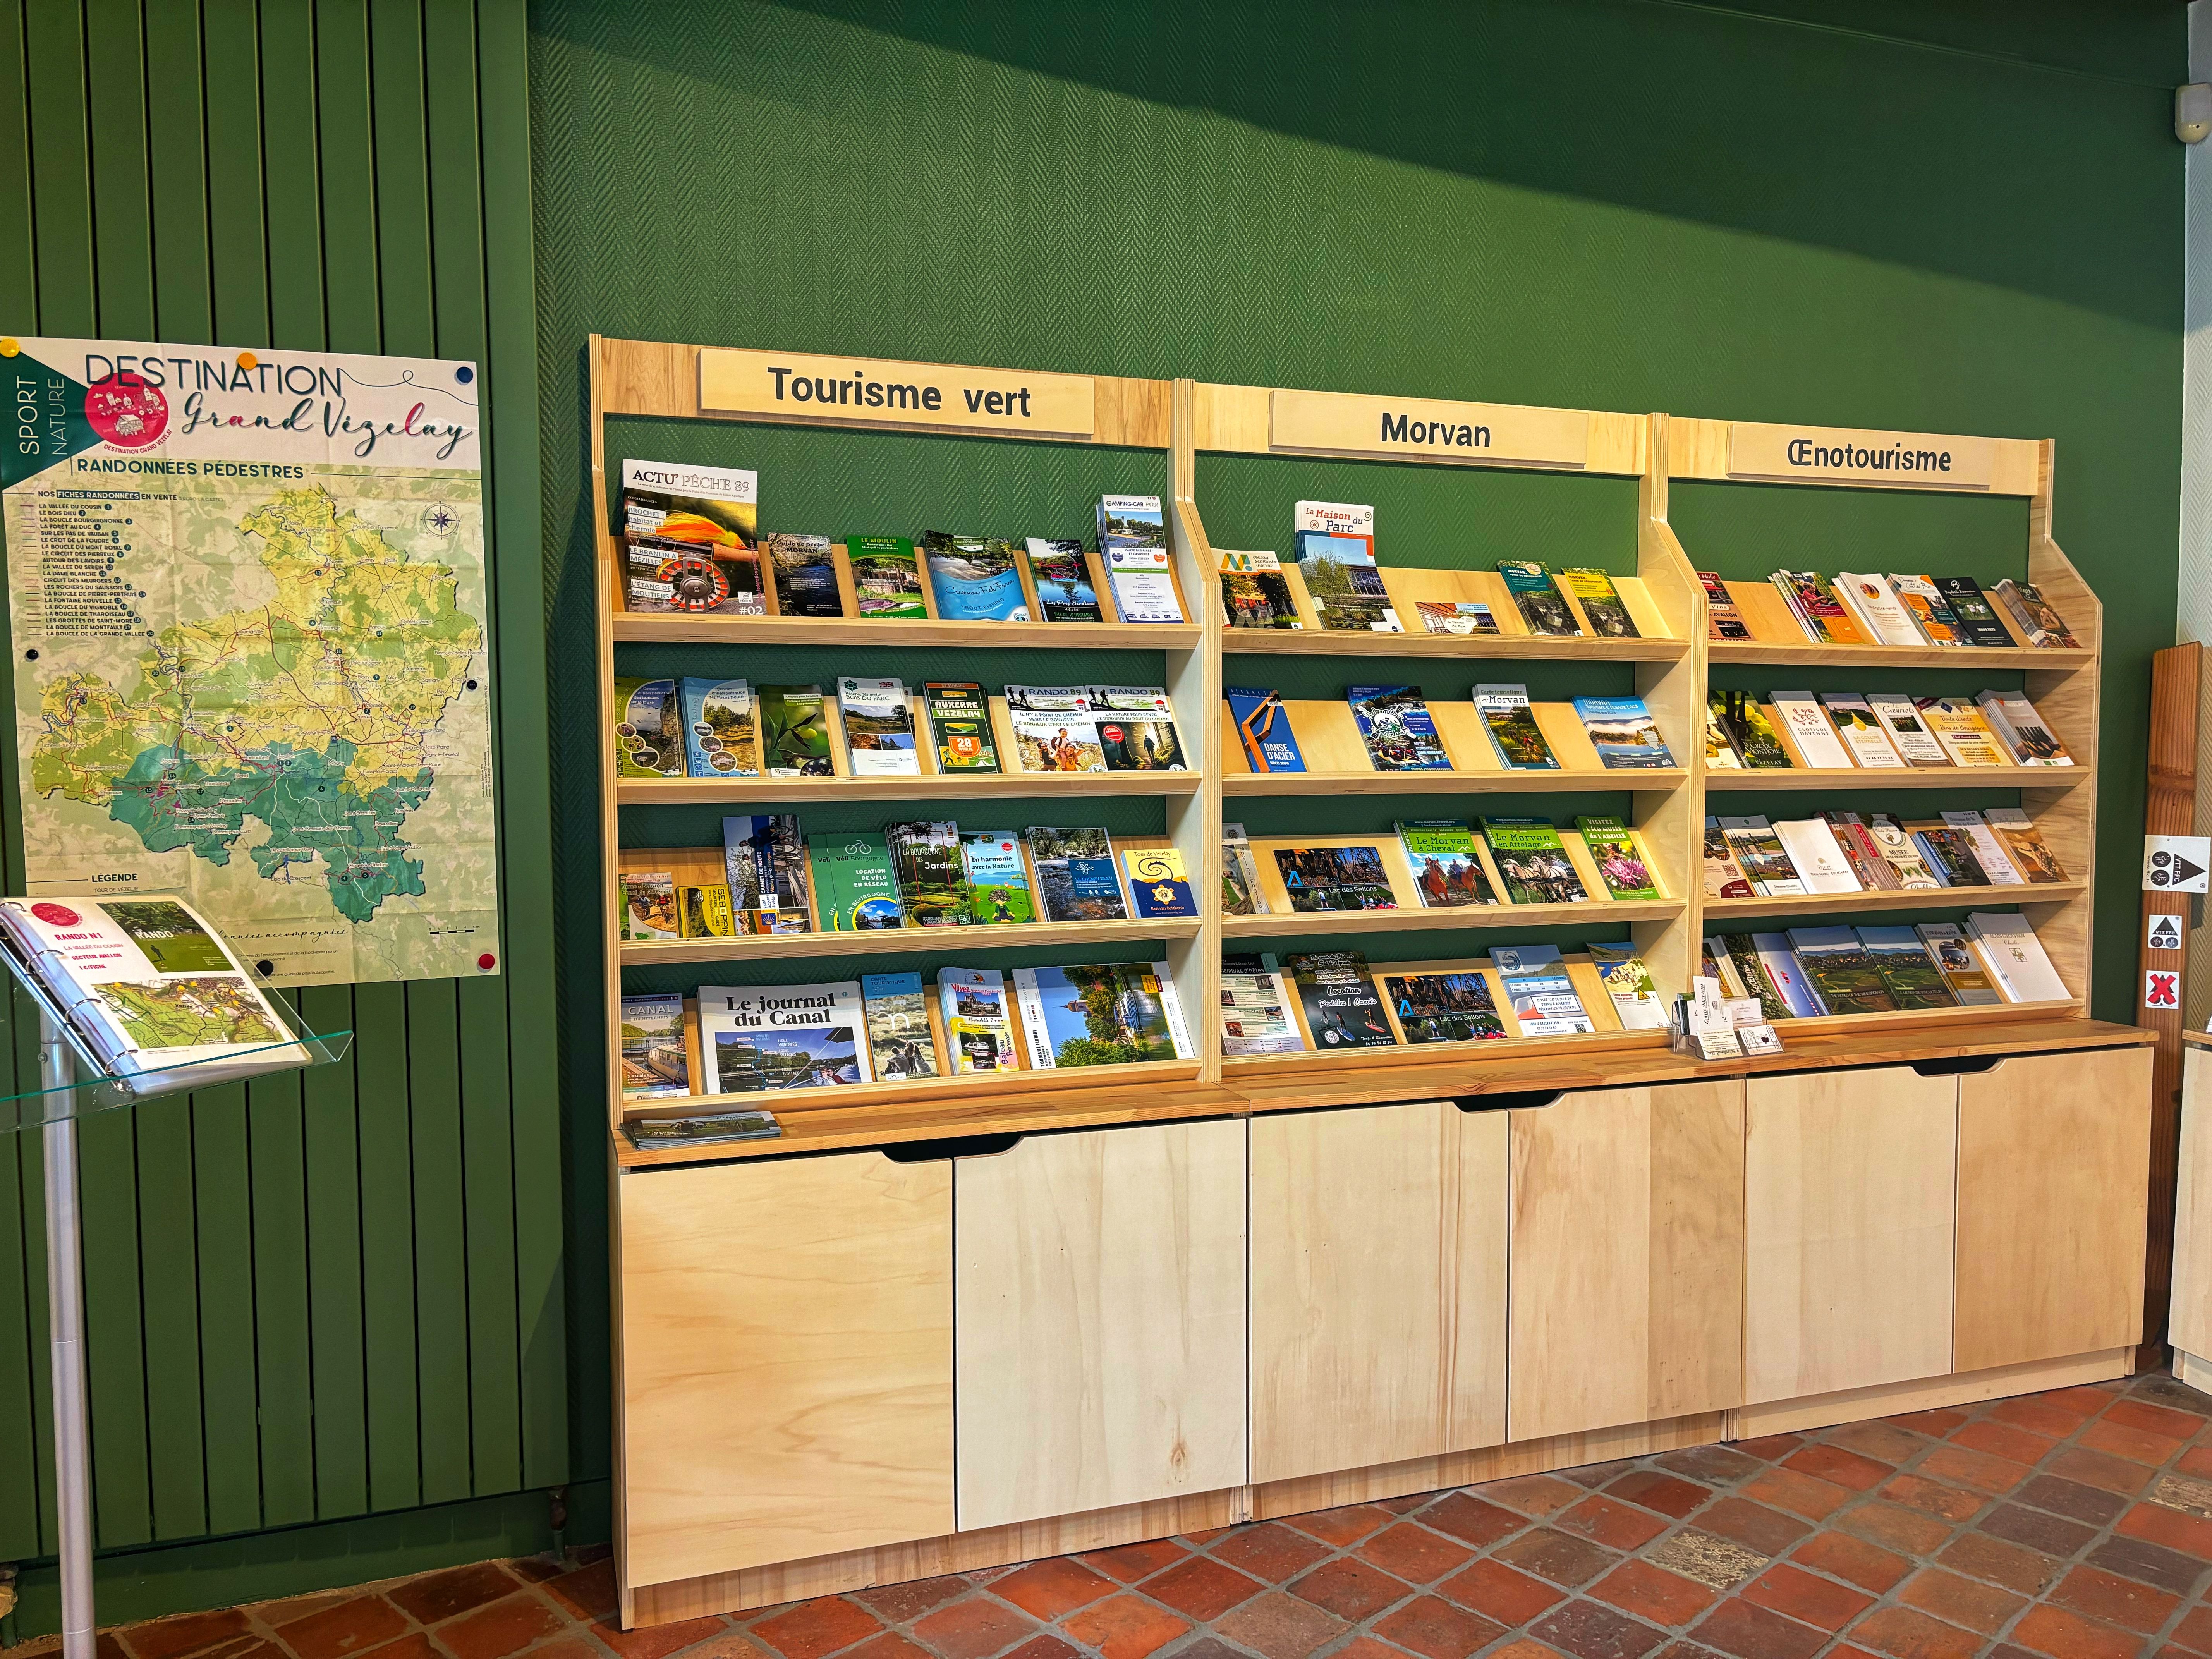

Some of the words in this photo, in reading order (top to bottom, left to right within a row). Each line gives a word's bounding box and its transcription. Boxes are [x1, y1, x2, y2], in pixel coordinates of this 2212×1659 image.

[86, 354, 342, 397] DESTINATION
[768, 366, 942, 411] Tourisme
[963, 386, 1032, 418] vert
[17, 376, 40, 455] SPORT
[48, 378, 68, 455] NATURE
[182, 392, 314, 434] Grand
[324, 397, 473, 459] Vézelay
[1381, 412, 1492, 448] Morvan
[103, 443, 139, 455] DESTINATION
[140, 443, 157, 454] GRAND
[1788, 438, 1953, 473] Œnotourisme
[77, 459, 197, 476] RANDONNÉES
[203, 460, 303, 479] PÉDESTRES
[682, 474, 732, 491] PÊCHE
[735, 481, 750, 492] 89
[628, 507, 661, 519] BROCHET
[1315, 509, 1350, 520] Maison
[628, 515, 652, 525] habitat
[629, 524, 656, 534] thermie
[1326, 520, 1354, 533] Parc
[639, 548, 670, 558] BRANLIN
[630, 555, 663, 565] MÉZILLES
[632, 579, 659, 591] L'ÉTANG
[977, 584, 996, 594] Fish
[995, 579, 1015, 589] Farm
[632, 589, 671, 599] MOUTIERS
[983, 598, 1005, 608] FISHING
[739, 606, 764, 616] #02
[957, 738, 972, 747] 28
[1264, 743, 1289, 752] DANSE
[1267, 750, 1295, 761] D'ACIER
[1509, 841, 1541, 849] Attelage
[92, 873, 138, 882] LÉGENDE
[847, 906, 853, 915] EN
[852, 892, 890, 907] BOURGOGNE
[135, 931, 174, 939] RANDO
[1327, 986, 1361, 996] Location
[726, 996, 752, 1011] Le
[759, 992, 836, 1014] journal
[1319, 999, 1346, 1008] Paddles
[629, 1005, 674, 1015] CANAL
[734, 1012, 762, 1027] du
[770, 1009, 831, 1026] Canal
[1006, 1031, 1014, 1057] Promenade
